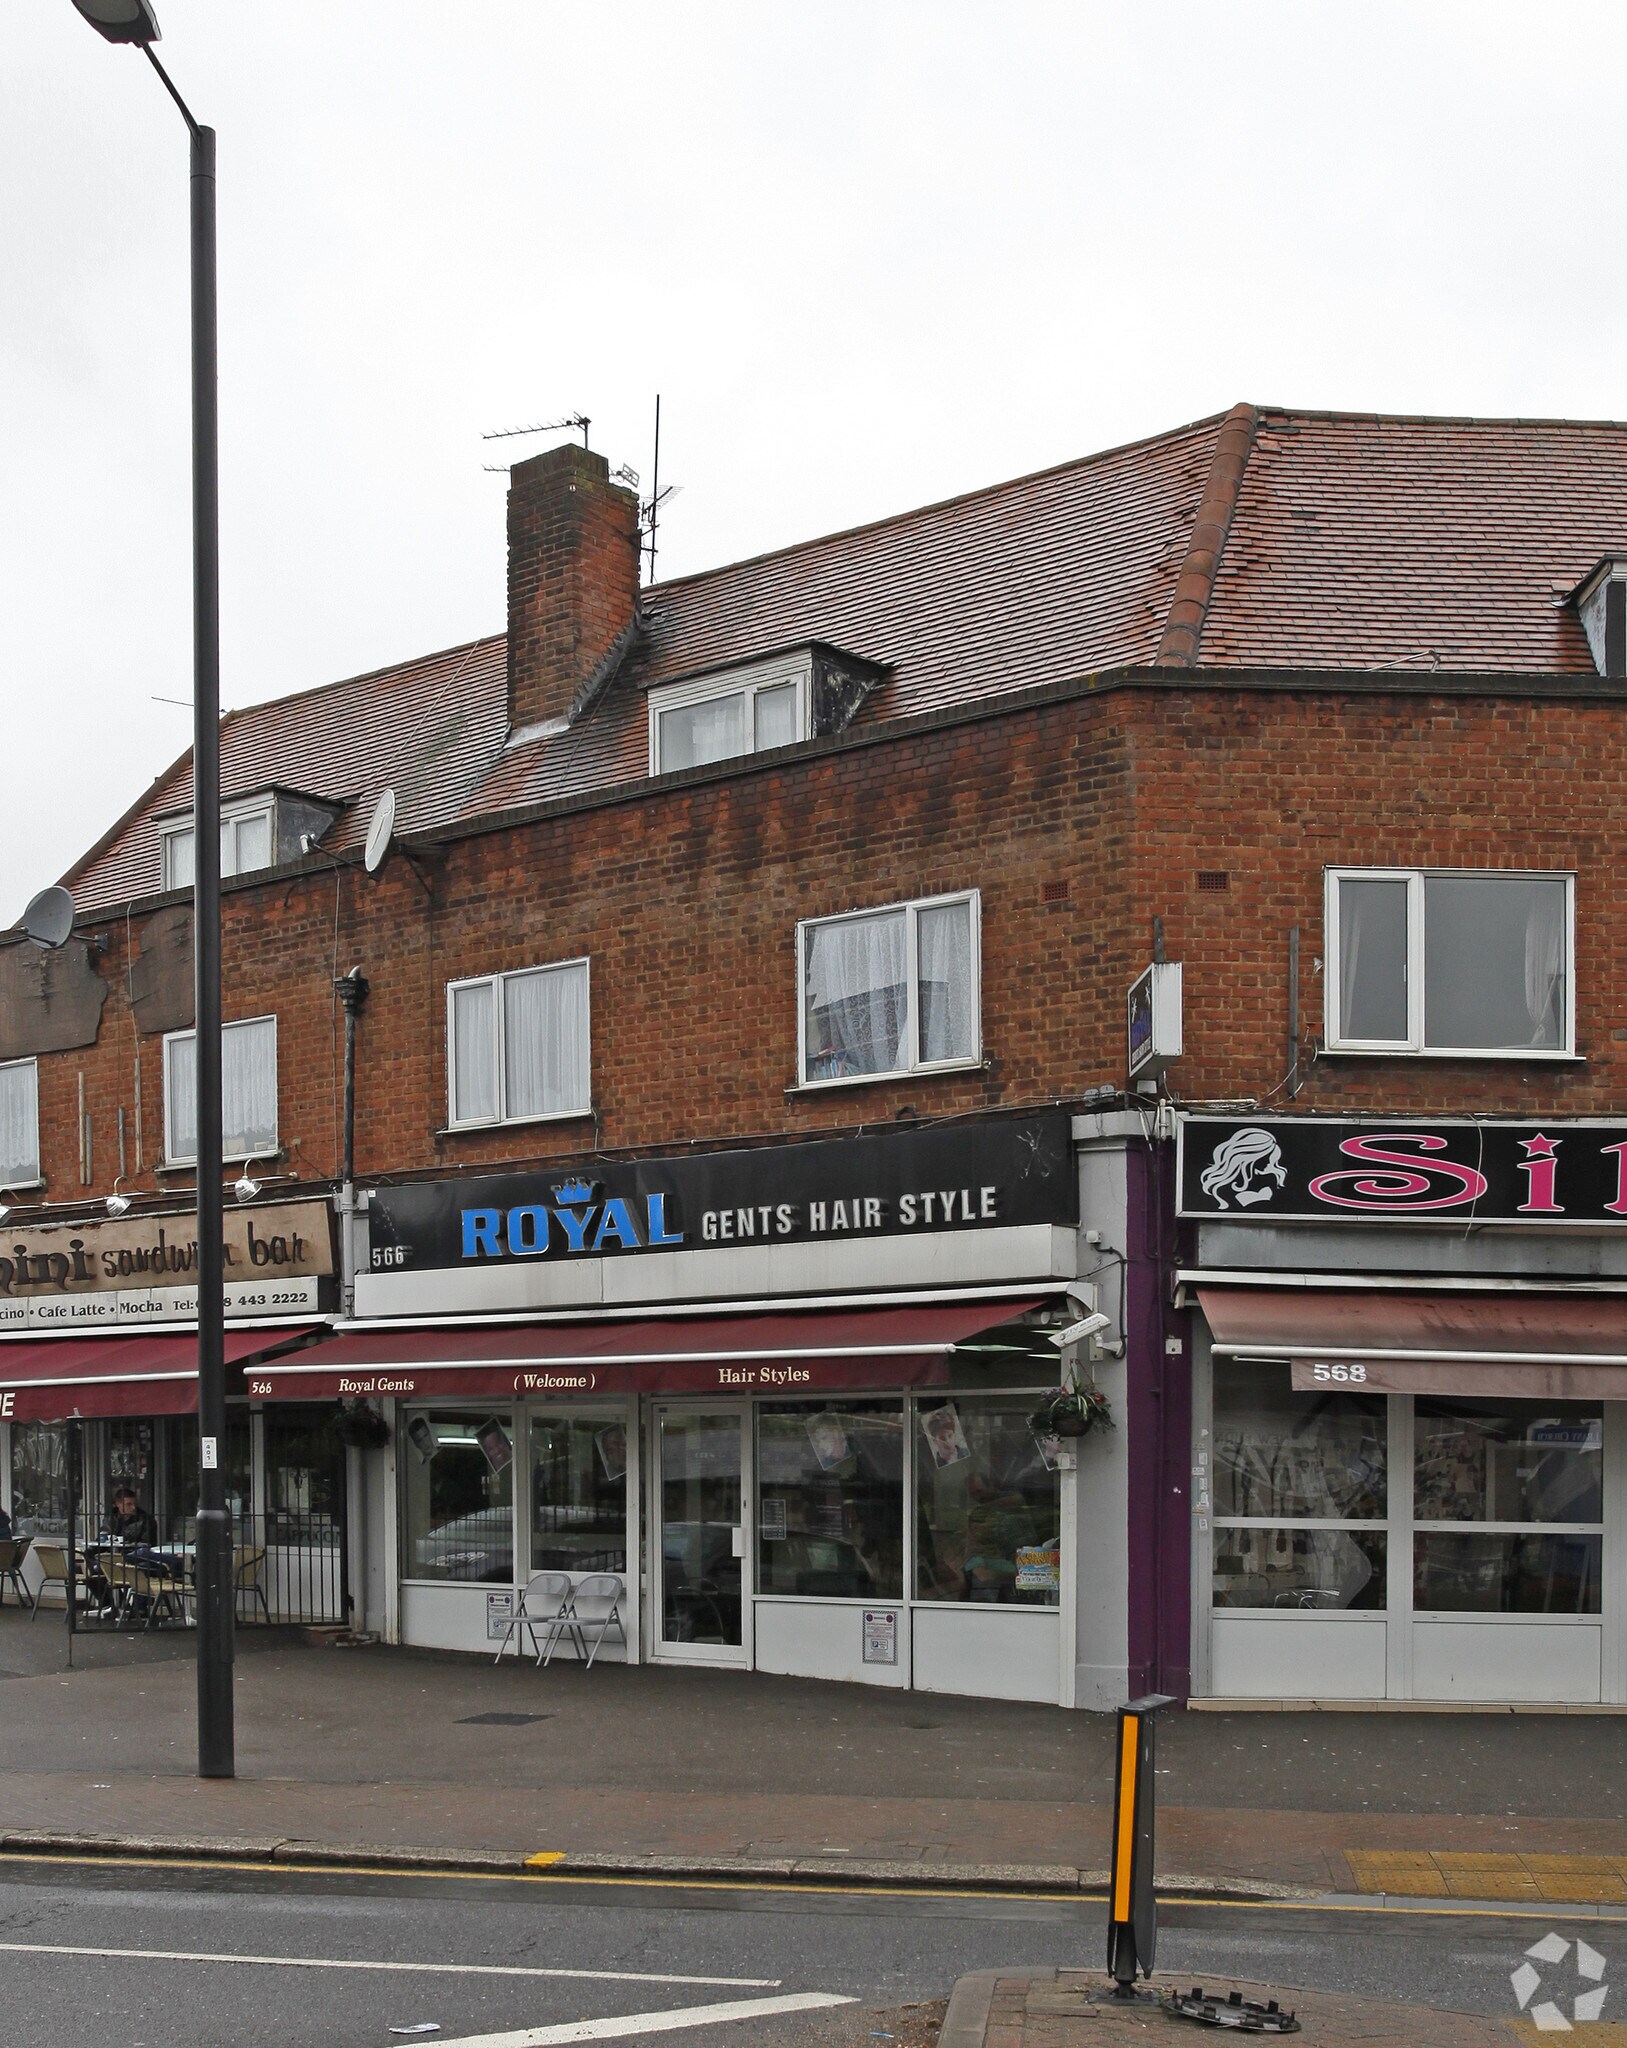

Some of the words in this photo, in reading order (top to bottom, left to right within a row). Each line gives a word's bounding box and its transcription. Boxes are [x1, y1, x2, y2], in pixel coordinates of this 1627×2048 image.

[460, 1193, 684, 1258] ROYAL
[702, 1203, 793, 1241] GENTS
[809, 1197, 882, 1232] HAIR
[899, 1186, 997, 1226] STYLE
[247, 1221, 306, 1267] bar
[372, 1247, 404, 1267] 566
[38, 1305, 67, 1318] Cafe
[71, 1304, 106, 1317] Latte
[119, 1301, 163, 1314] Mocha
[238, 1294, 266, 1306] 443
[272, 1292, 308, 1304] 2222
[718, 1368, 756, 1384] Hair
[760, 1366, 810, 1383] Styles
[1313, 1363, 1367, 1383] 568
[252, 1381, 272, 1394] 566
[338, 1378, 375, 1394] Royal
[377, 1377, 414, 1392] Gents
